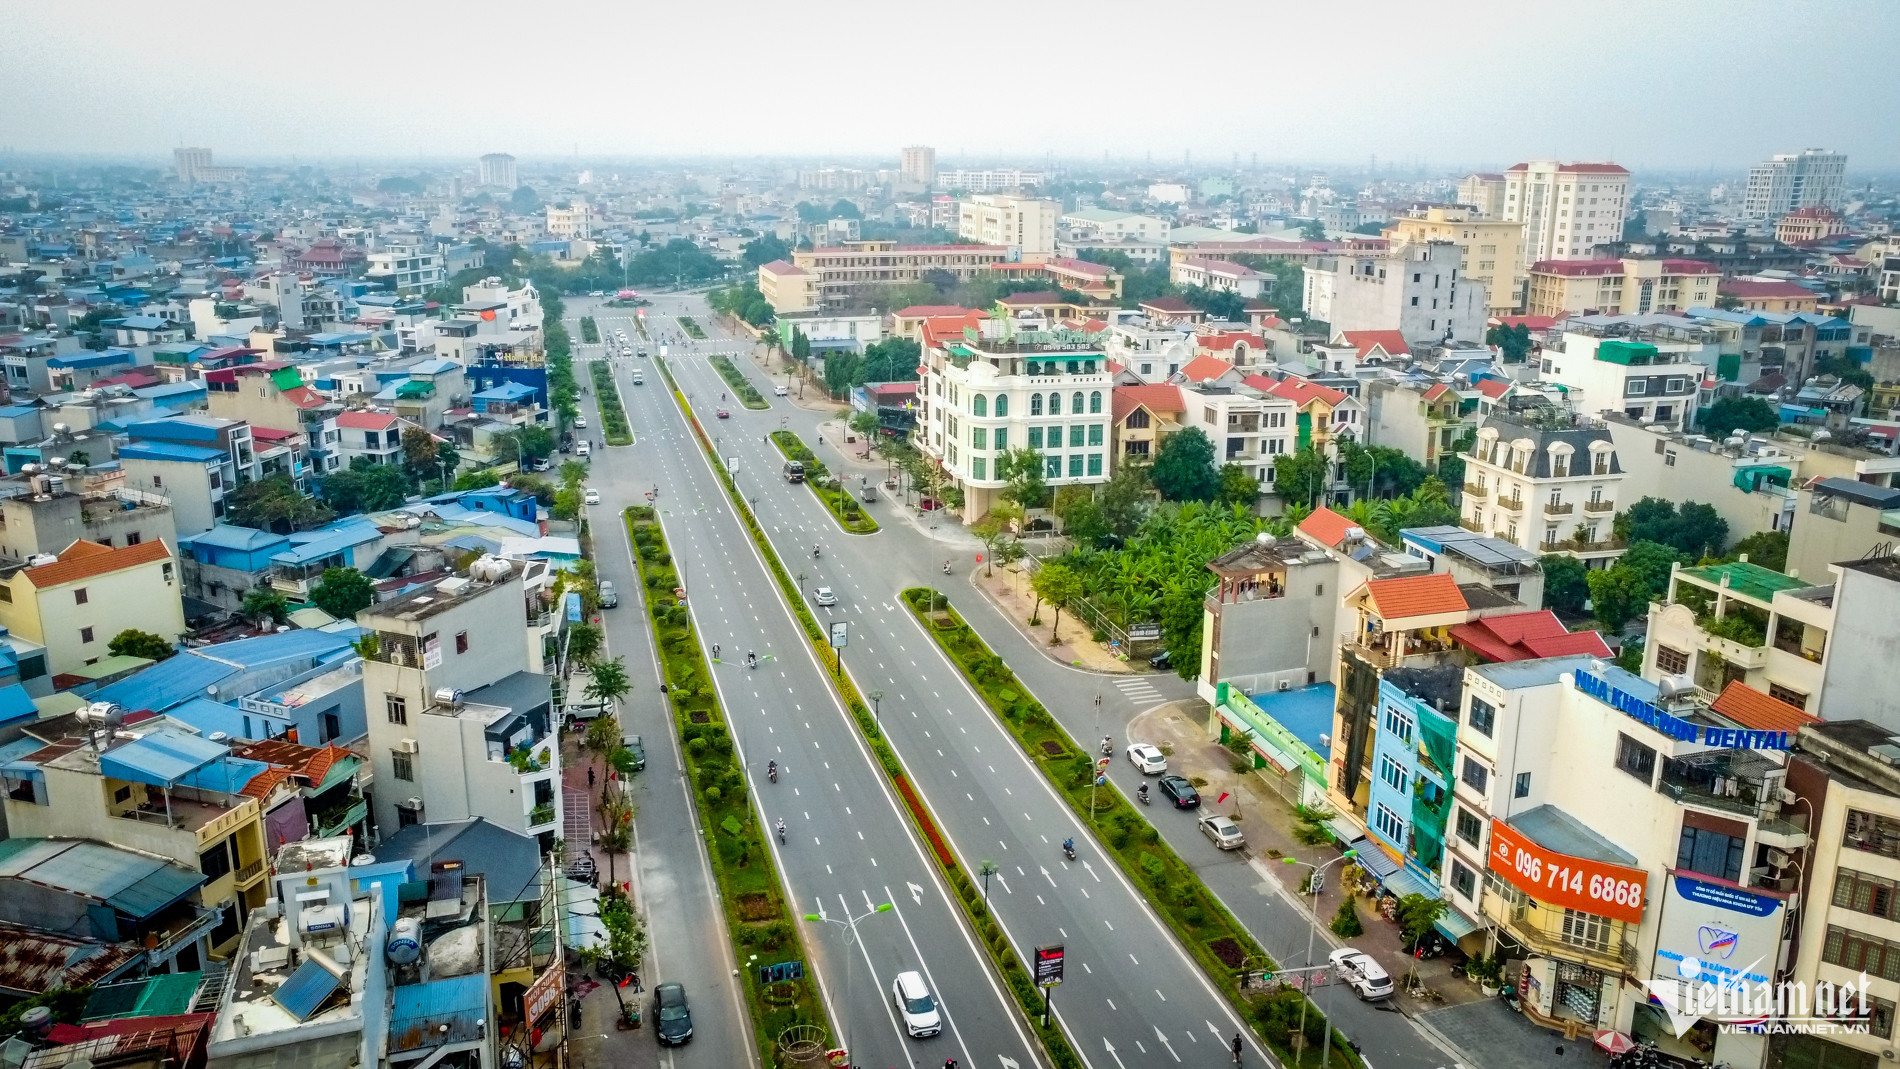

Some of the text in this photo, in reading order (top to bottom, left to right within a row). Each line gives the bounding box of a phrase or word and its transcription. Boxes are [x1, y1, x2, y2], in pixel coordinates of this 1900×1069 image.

[1575, 668, 1791, 751] NHA KHOA WIN DENTAL
[1515, 847, 1542, 883] 096
[1547, 863, 1583, 895] 714
[1589, 873, 1642, 908] 6868
